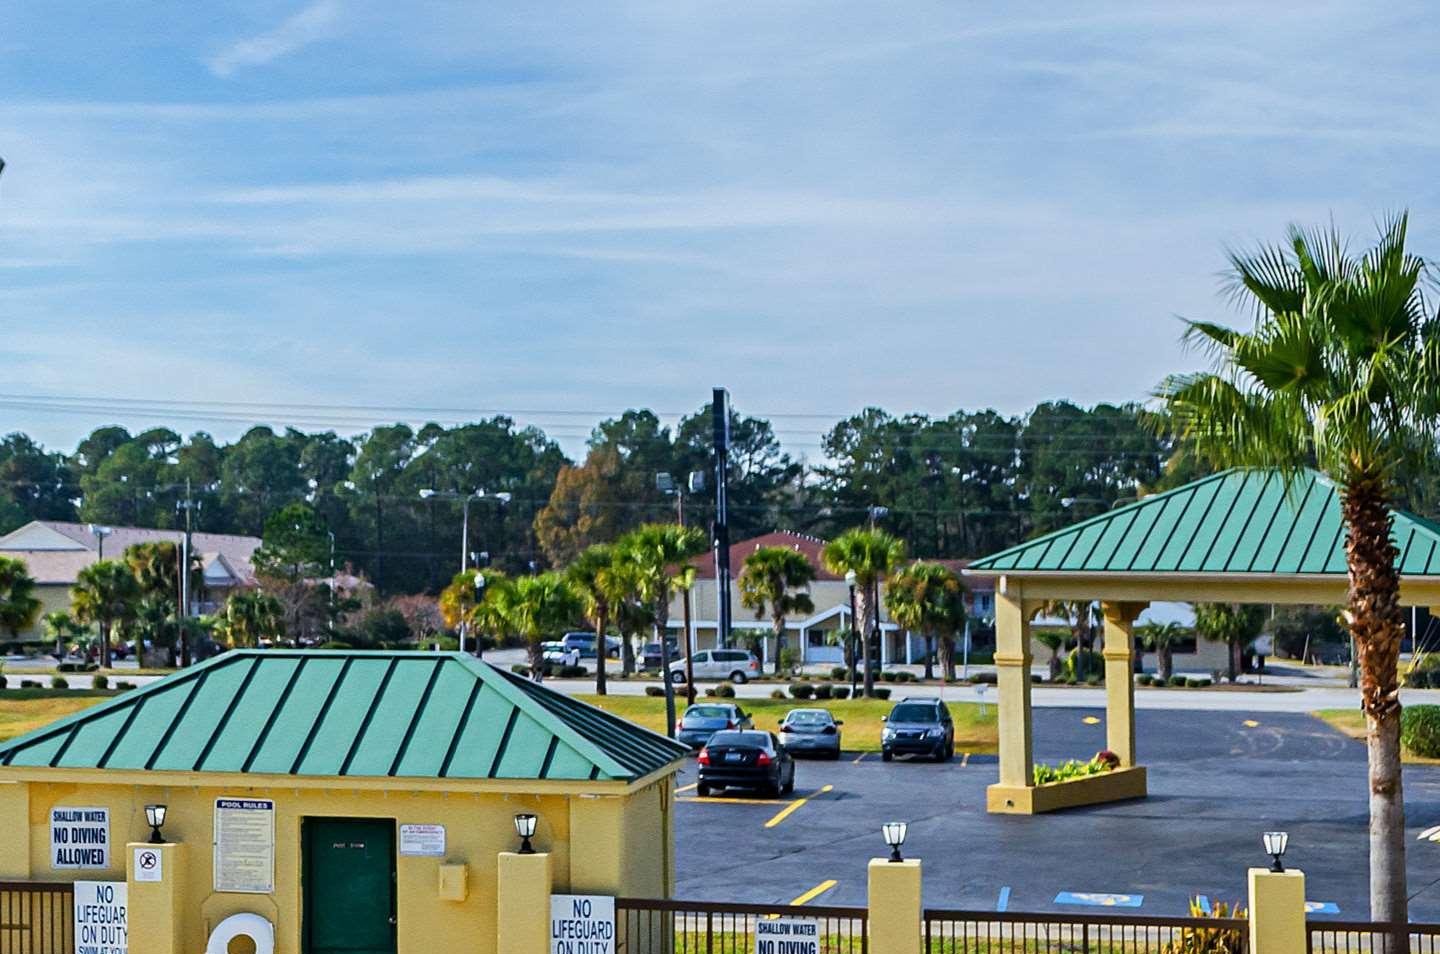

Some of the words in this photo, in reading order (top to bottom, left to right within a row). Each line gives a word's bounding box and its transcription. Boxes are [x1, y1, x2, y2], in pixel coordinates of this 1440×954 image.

[53, 811, 83, 822] SHALLOW
[84, 811, 106, 822] WATER
[53, 828, 68, 844] NO
[71, 828, 106, 844] DIVING
[56, 848, 105, 865] ALLOWED
[96, 885, 114, 904] NO
[77, 905, 126, 924] LIFEGUAR
[573, 899, 592, 918] NO
[81, 925, 97, 944] ON
[552, 920, 613, 940] LIFEGUARD
[758, 923, 791, 935] SHALLOW
[792, 924, 816, 936] WATER
